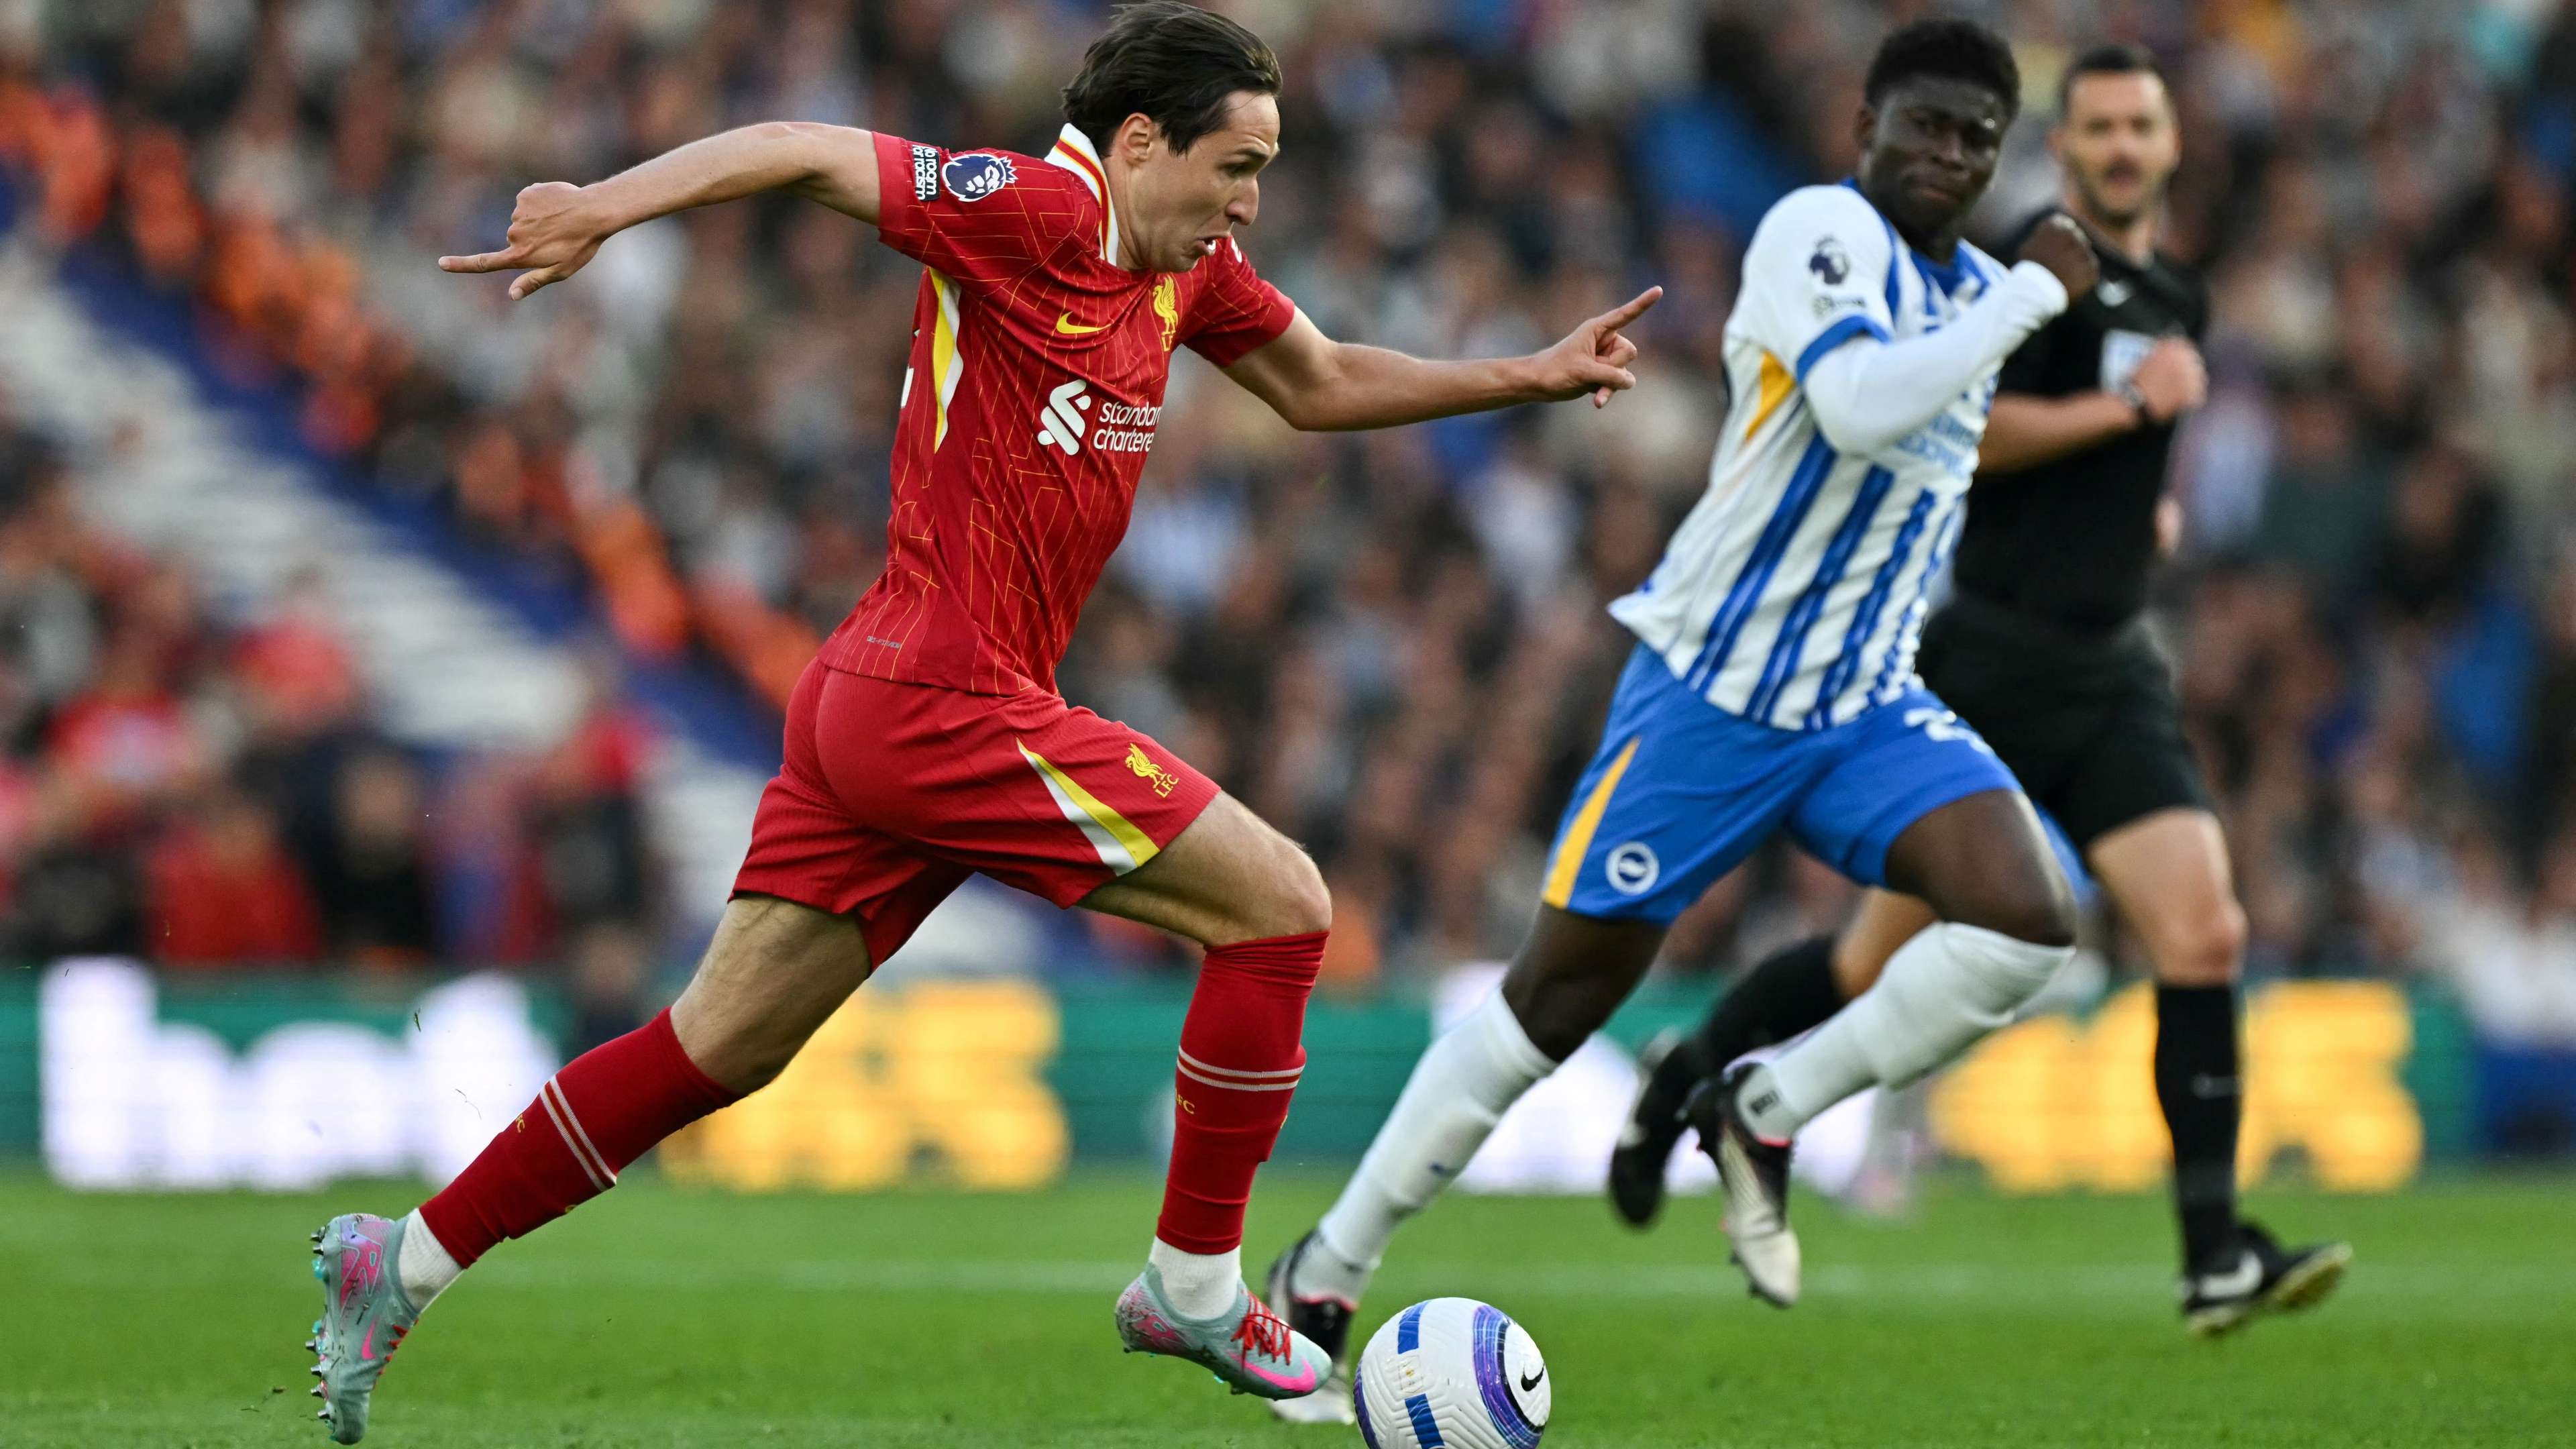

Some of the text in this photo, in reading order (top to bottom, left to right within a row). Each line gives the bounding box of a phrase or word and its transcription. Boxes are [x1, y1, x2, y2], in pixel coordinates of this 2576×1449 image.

[914, 158, 926, 200] racism
[926, 158, 937, 195] room
[1099, 401, 1162, 427] standar
[1093, 425, 1155, 452] chartere
